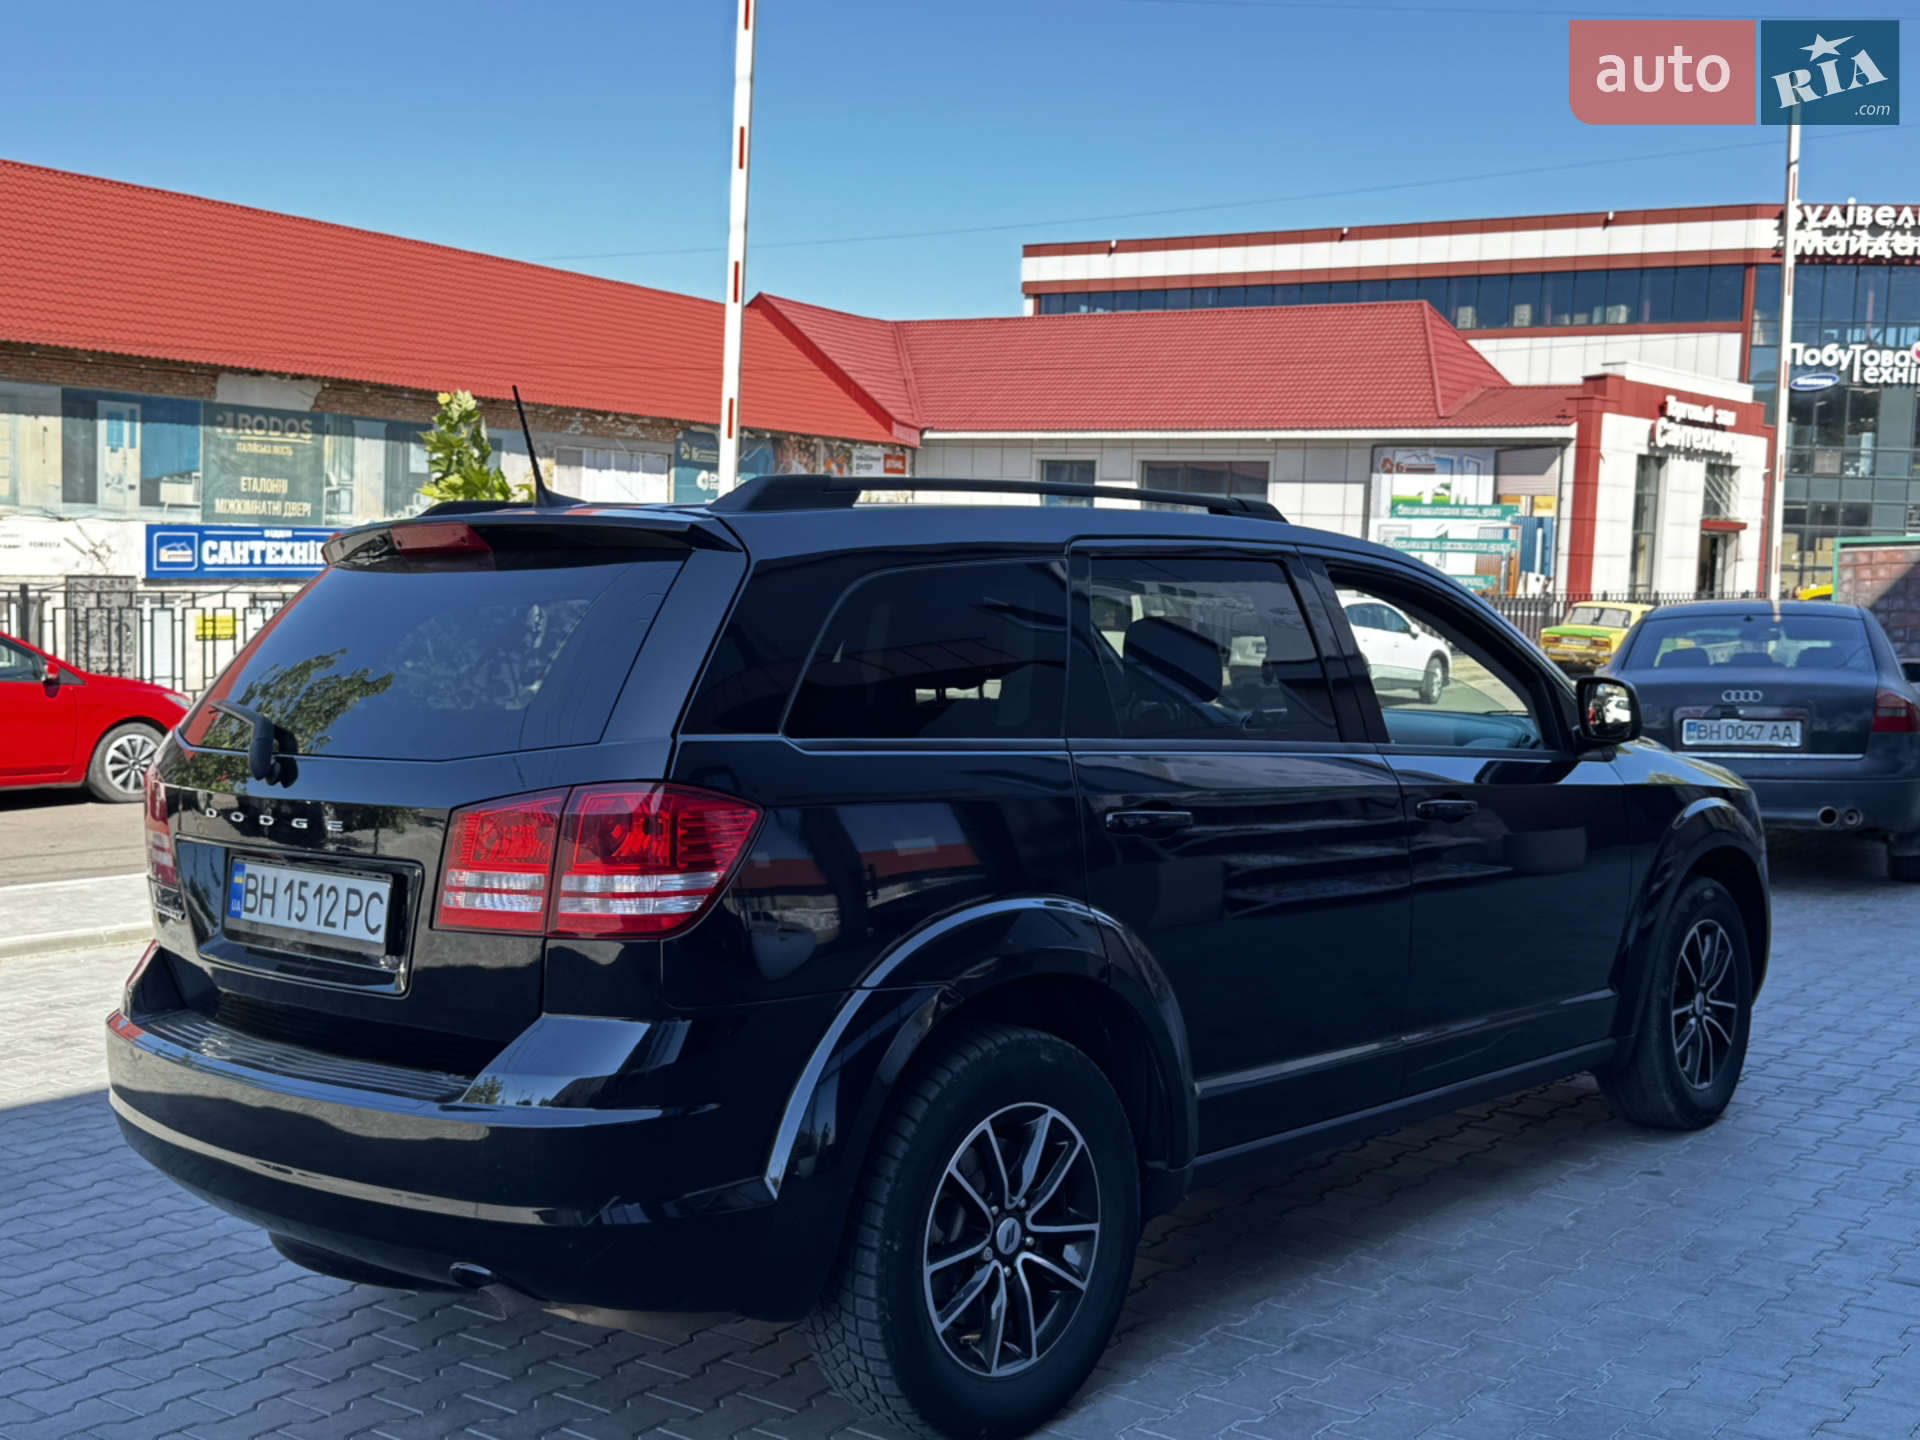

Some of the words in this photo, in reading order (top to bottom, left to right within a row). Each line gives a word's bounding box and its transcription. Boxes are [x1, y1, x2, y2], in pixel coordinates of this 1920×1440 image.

[1795, 197, 1920, 232] удівел
[1794, 229, 1920, 259] Майда
[237, 412, 314, 440] RODOS
[1725, 724, 1764, 741] 0047
[205, 807, 344, 832] DODGE
[283, 879, 340, 929] 1512
